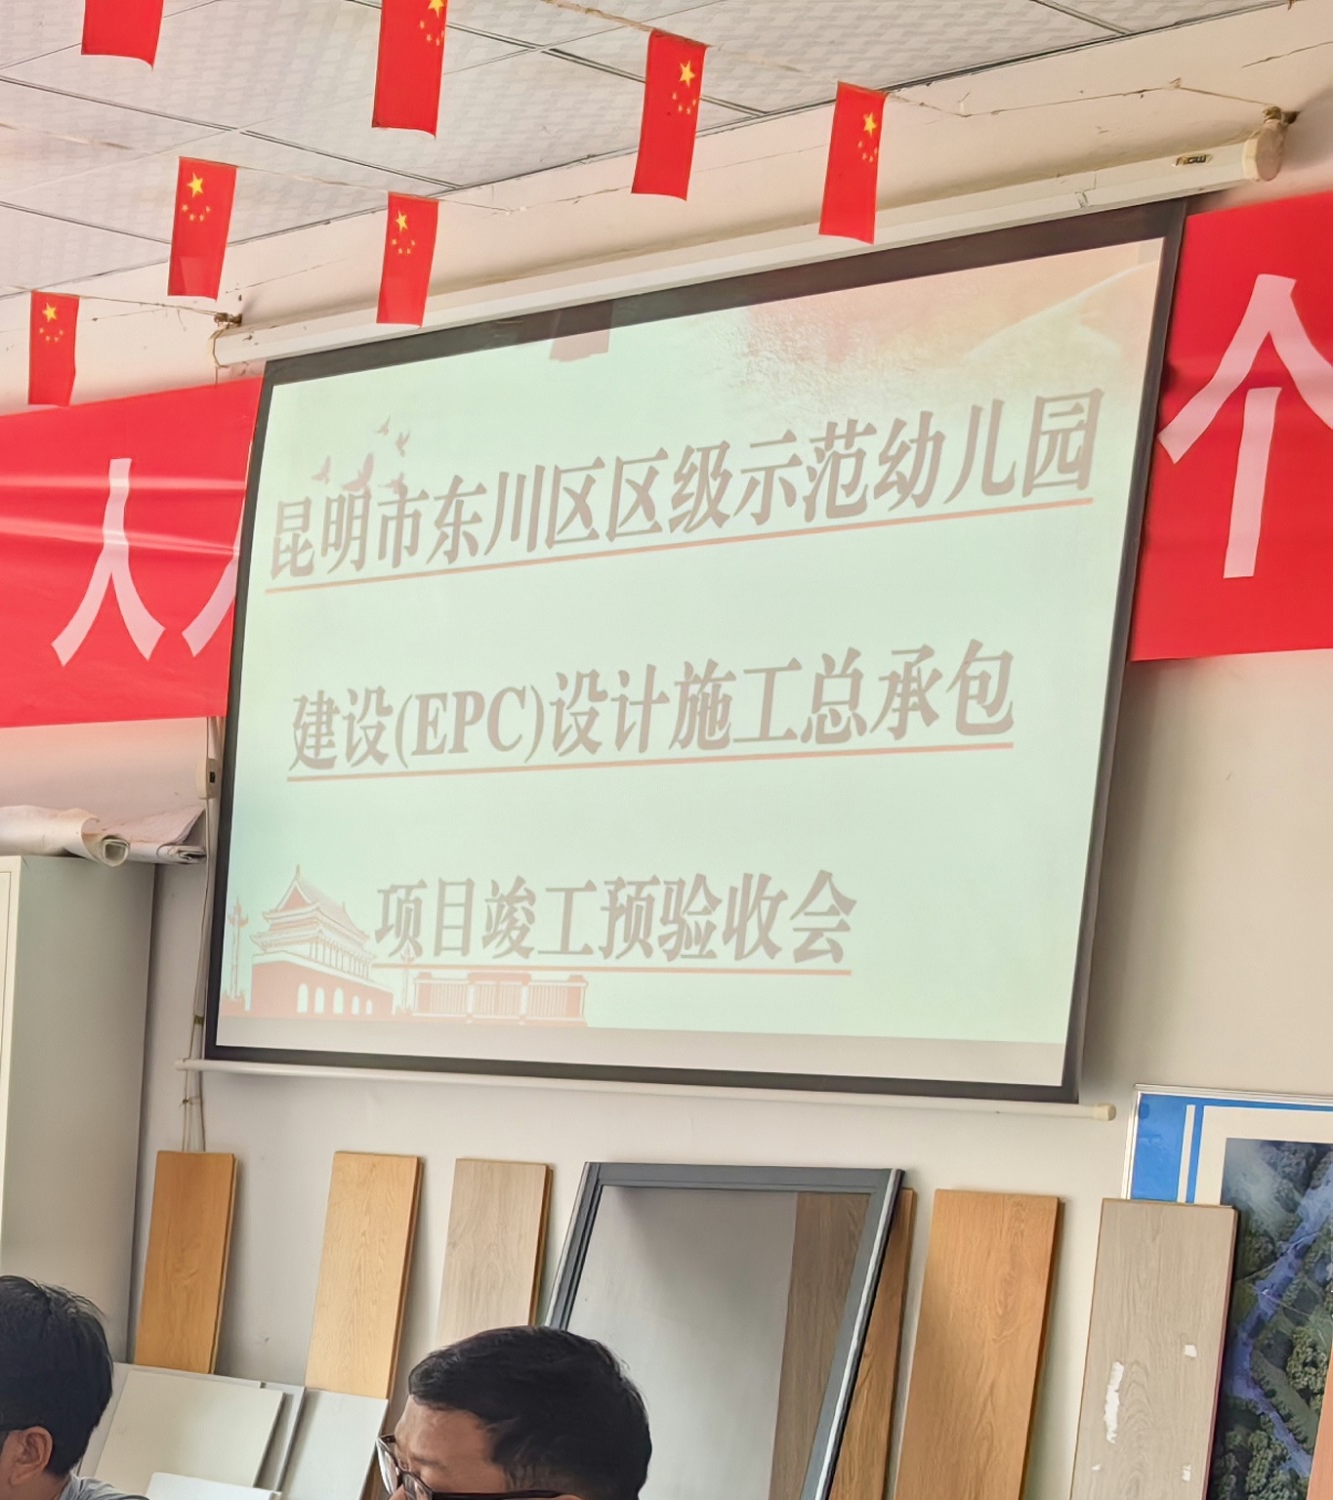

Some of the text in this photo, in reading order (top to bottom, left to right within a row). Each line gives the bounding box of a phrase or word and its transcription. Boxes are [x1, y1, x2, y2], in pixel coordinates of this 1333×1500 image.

[271, 387, 1103, 582] 昆明市东川区区级示范幼儿园
[288, 638, 1014, 771] 建设(EPC)设计施工总承包
[373, 868, 858, 963] 项目竣工预验收会
